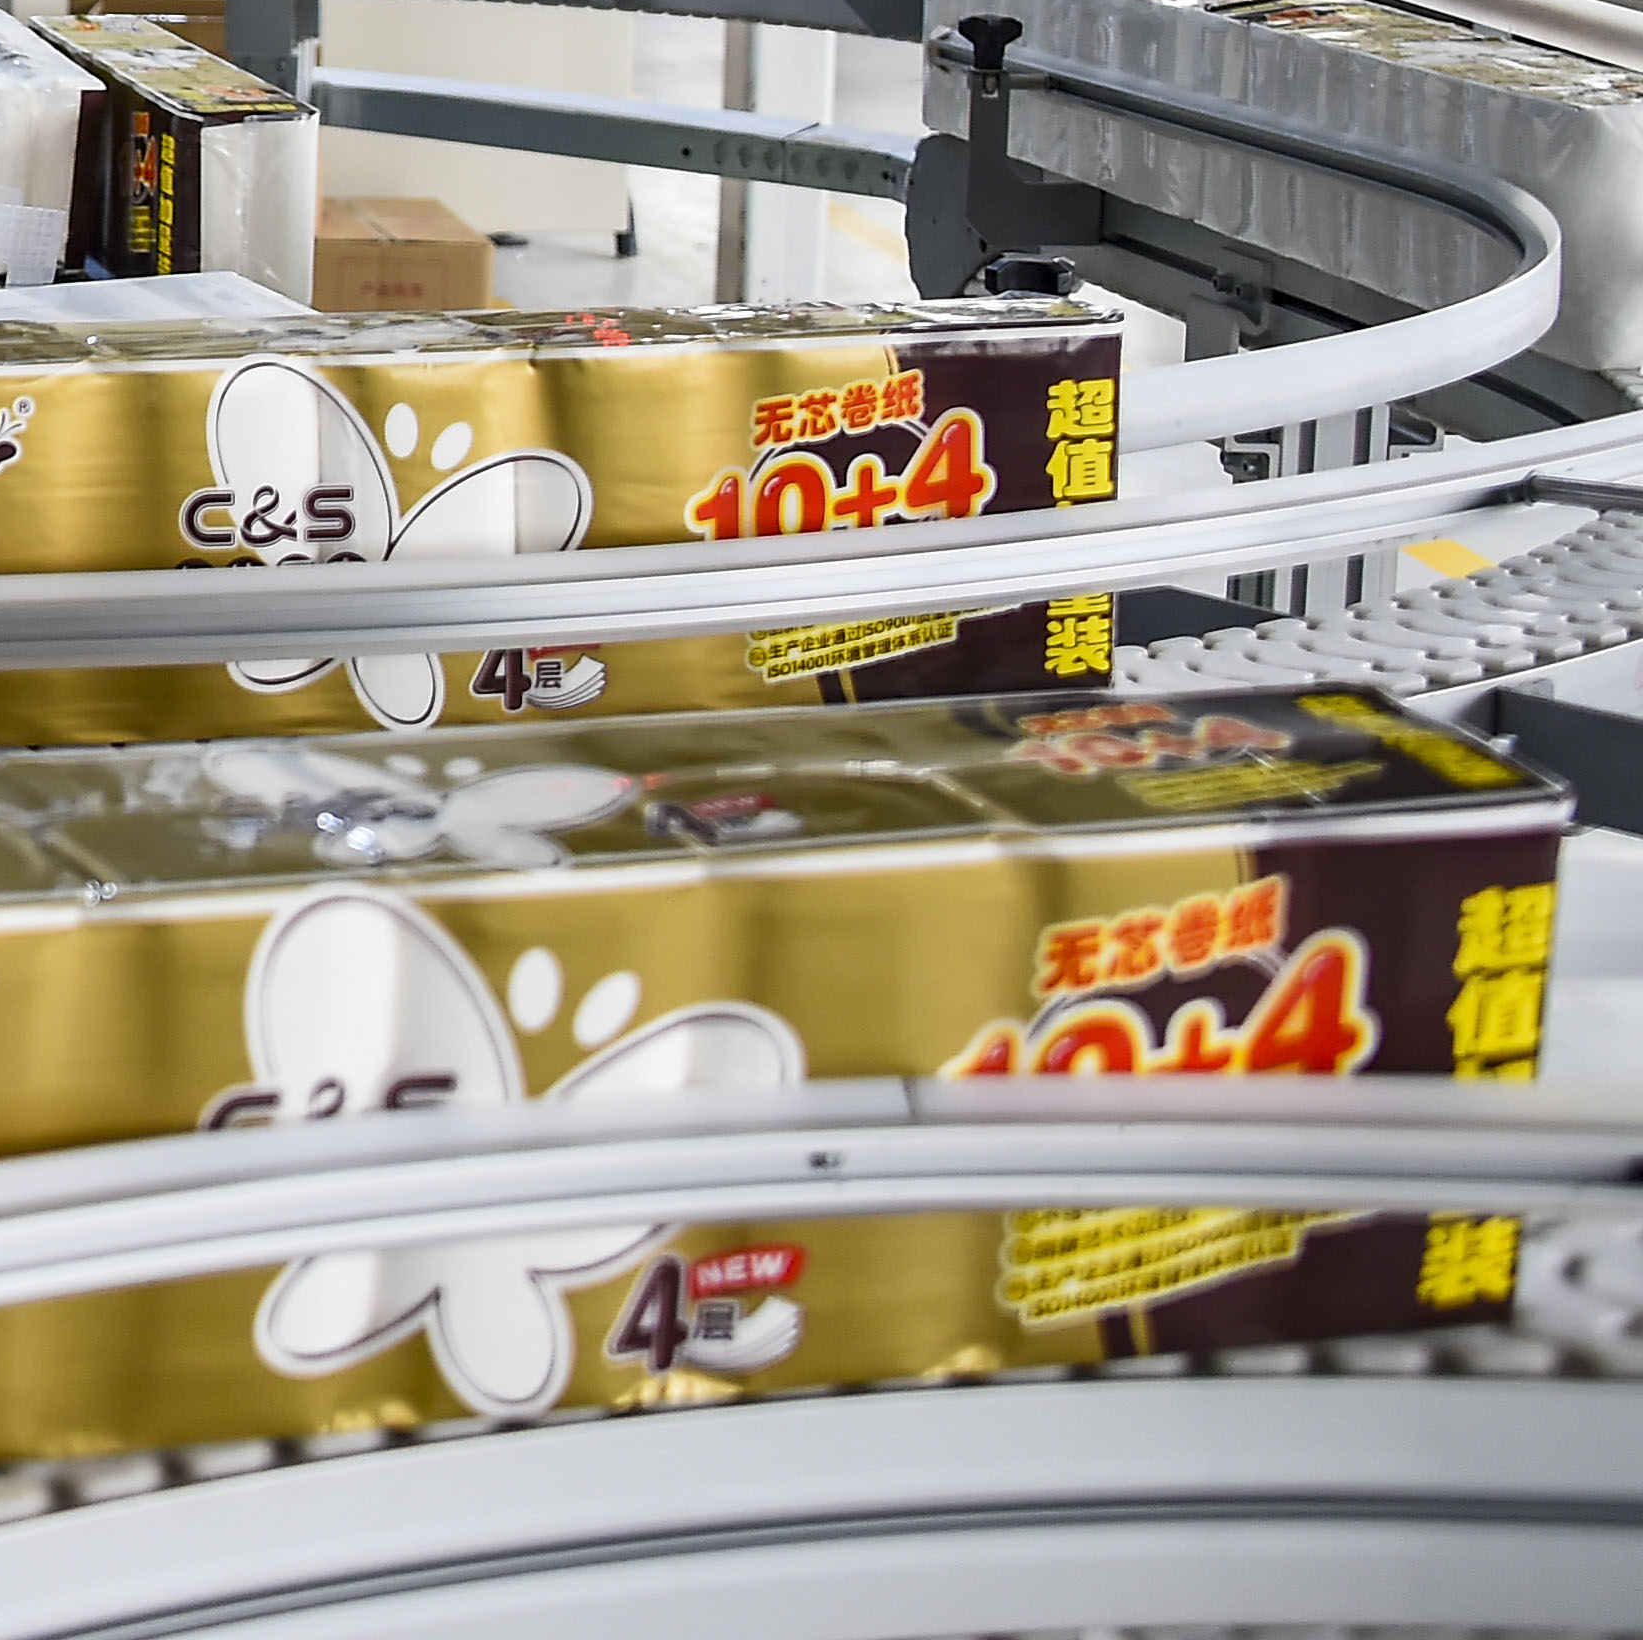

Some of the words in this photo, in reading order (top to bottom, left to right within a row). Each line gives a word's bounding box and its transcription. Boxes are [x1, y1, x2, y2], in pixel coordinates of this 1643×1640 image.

[753, 373, 923, 447] 无芯卷纸
[689, 412, 991, 540] 10+4
[180, 484, 356, 547] C&S
[1046, 378, 1115, 678] 超值装
[690, 1252, 788, 1291] NEW
